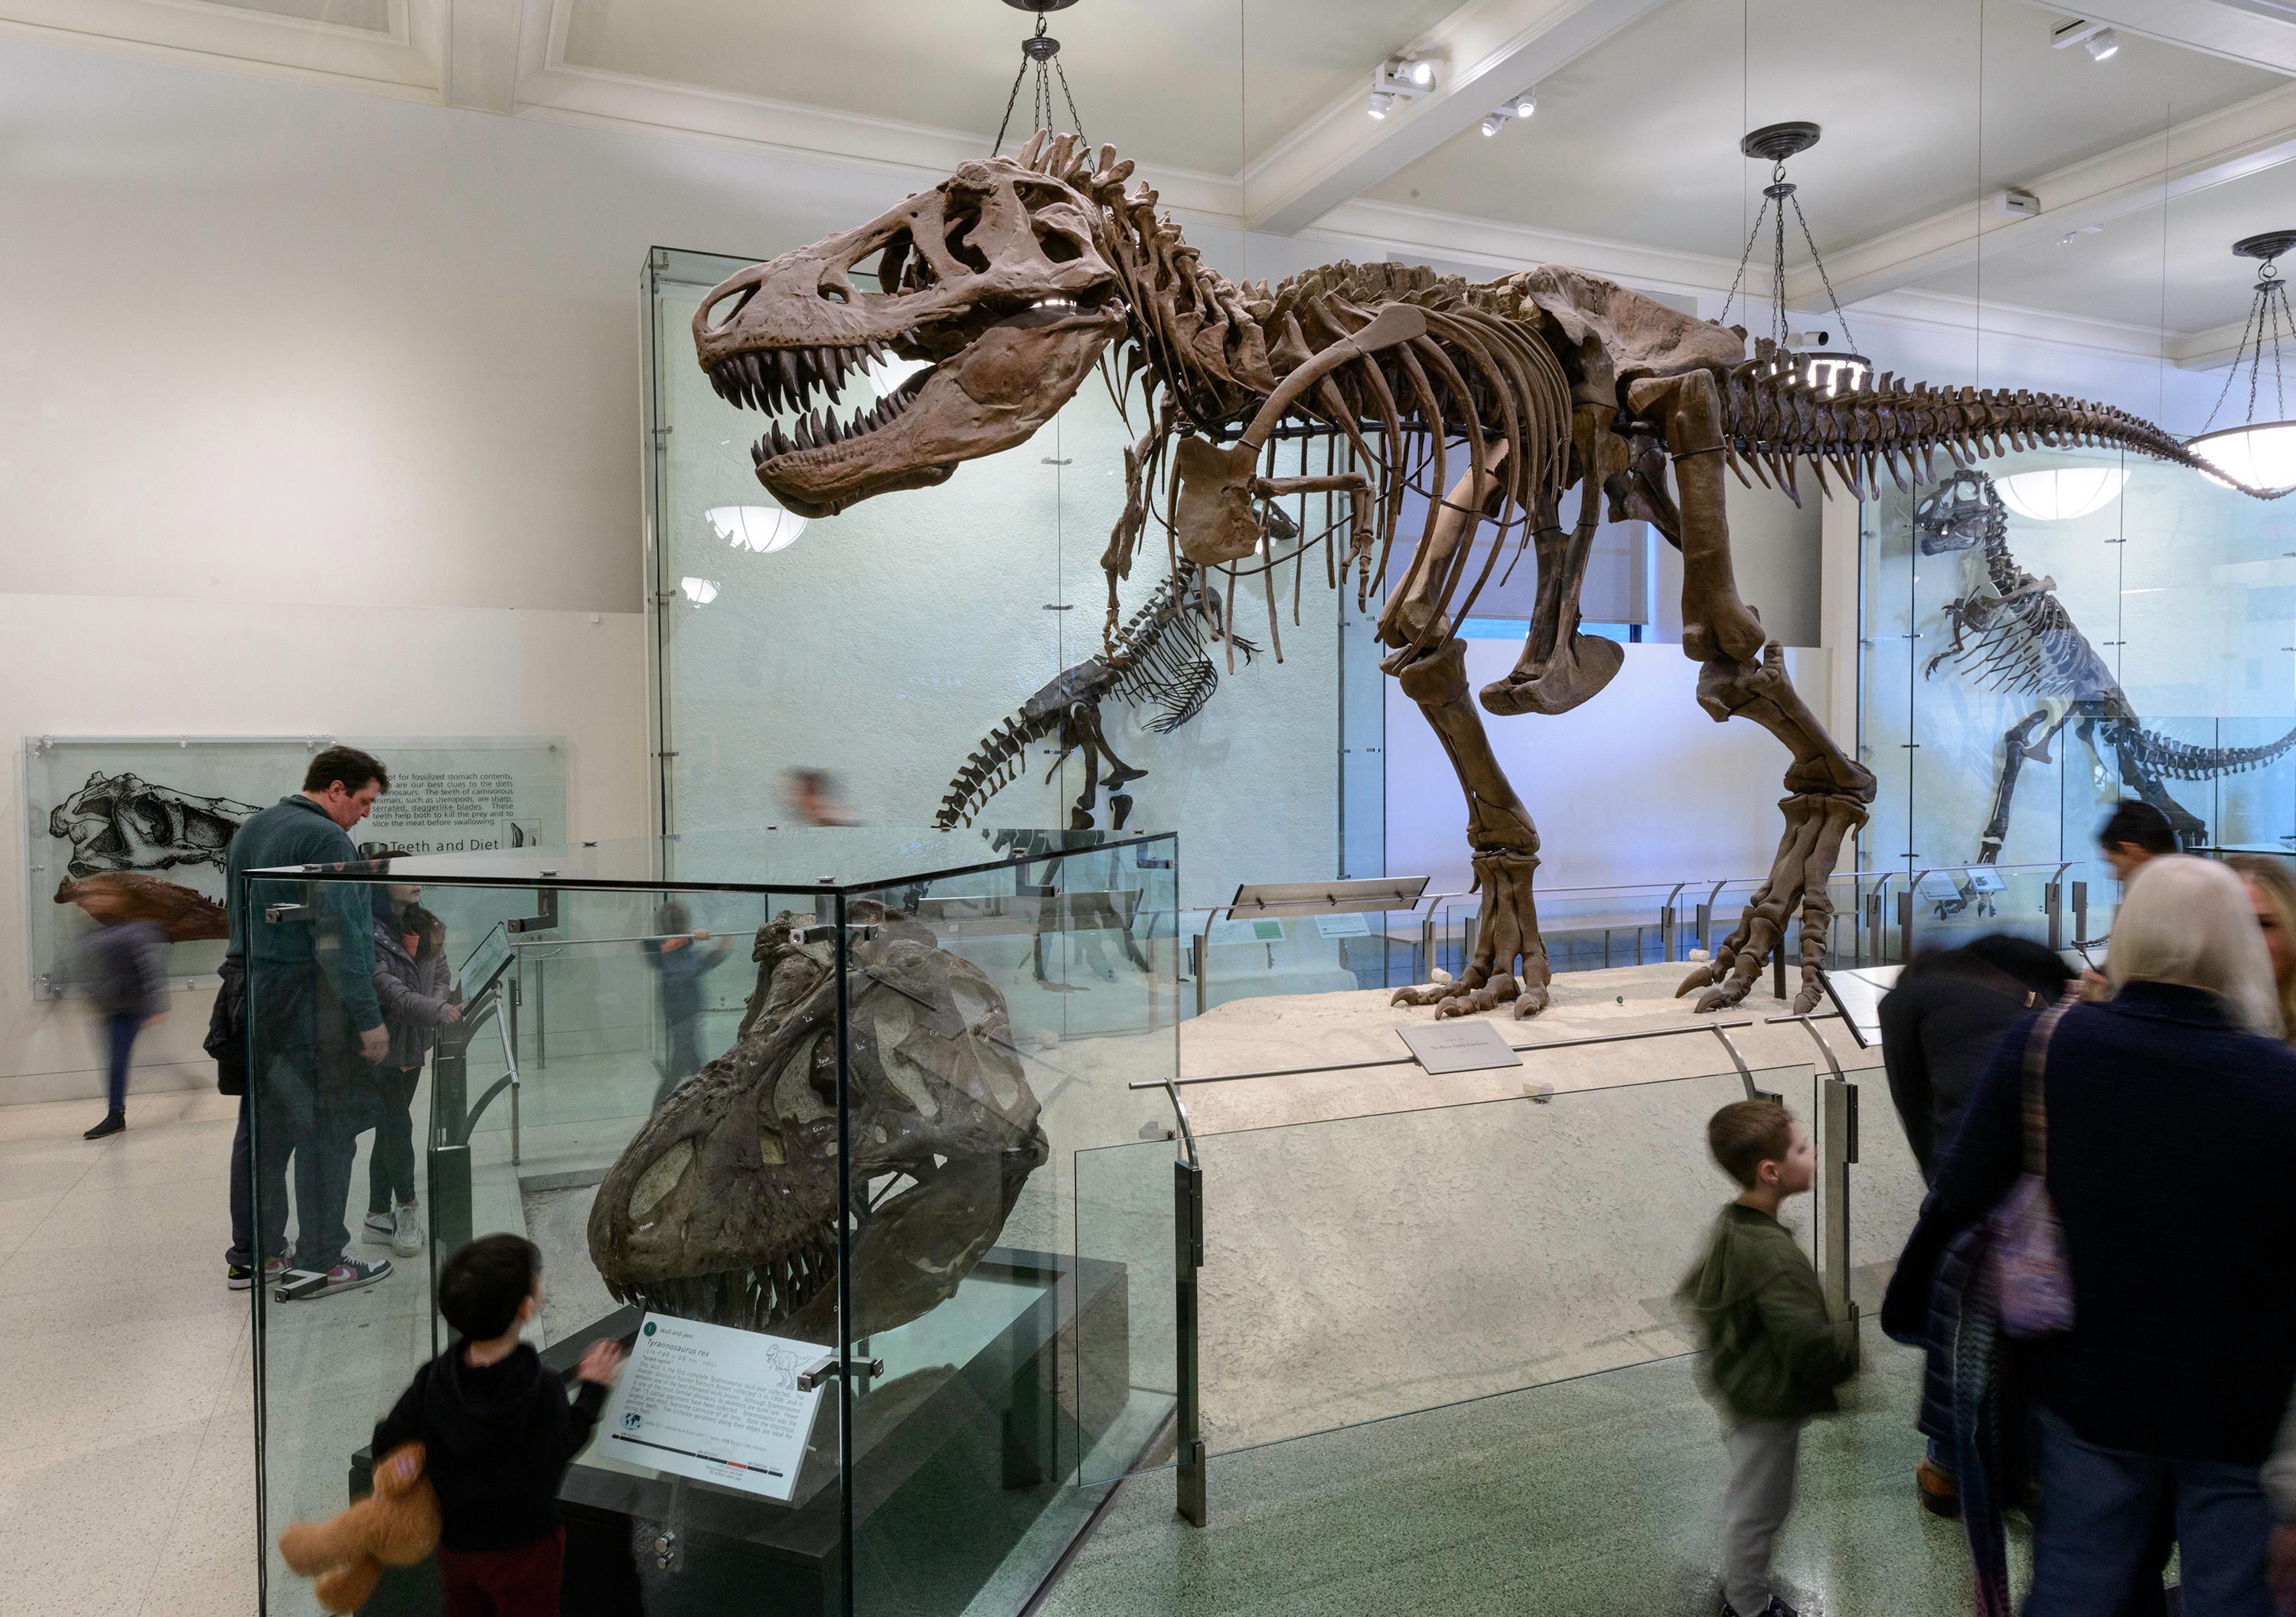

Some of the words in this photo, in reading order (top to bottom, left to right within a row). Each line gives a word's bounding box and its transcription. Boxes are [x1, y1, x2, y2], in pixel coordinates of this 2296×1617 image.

[436, 796, 475, 804] theropods,
[390, 841, 429, 852] Teeth
[437, 839, 464, 851] and
[471, 839, 498, 850] Diet
[646, 1338, 696, 1355] Tyrannosaurus
[743, 1397, 766, 1406] Although
[770, 1424, 794, 1433] enormous
